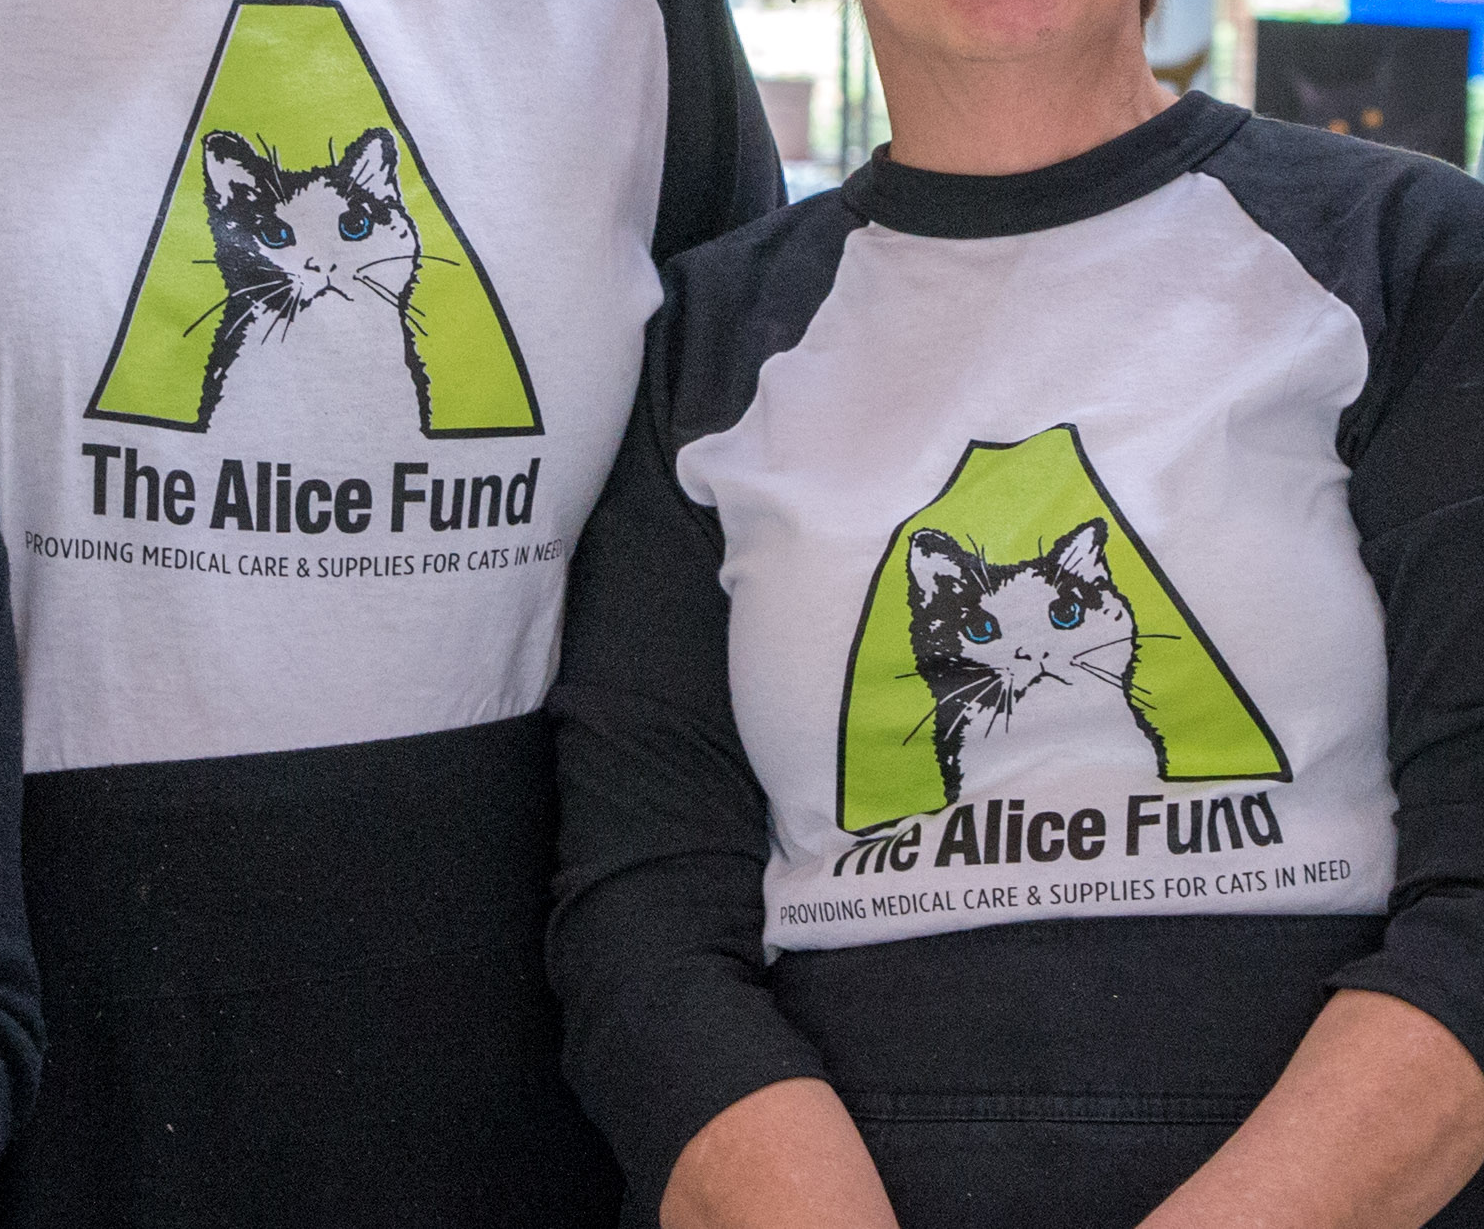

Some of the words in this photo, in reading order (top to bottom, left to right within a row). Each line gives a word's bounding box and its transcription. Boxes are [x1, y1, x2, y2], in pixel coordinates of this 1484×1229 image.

[82, 443, 195, 525] The
[210, 459, 372, 534] Alice
[391, 458, 540, 532] Fund
[25, 530, 133, 565] PROVIDING
[143, 545, 230, 574] MEDICAL
[239, 555, 288, 576] CARE
[297, 558, 309, 577] &
[318, 555, 414, 578] SUPPLIES
[423, 553, 460, 573] FOR
[468, 548, 509, 570] CATS
[514, 546, 530, 565] IN
[532, 538, 563, 562] NEED
[933, 798, 1106, 867] Alice
[781, 899, 866, 923] PROVIDING
[872, 892, 955, 916] MEDICAL
[964, 887, 1017, 909] CARE
[1027, 886, 1041, 905] &
[1051, 879, 1155, 904] SUPPLIES
[1165, 877, 1206, 898] FOR
[1216, 871, 1267, 894] CATS
[1276, 867, 1295, 888] IN
[1304, 860, 1350, 883] NEED
